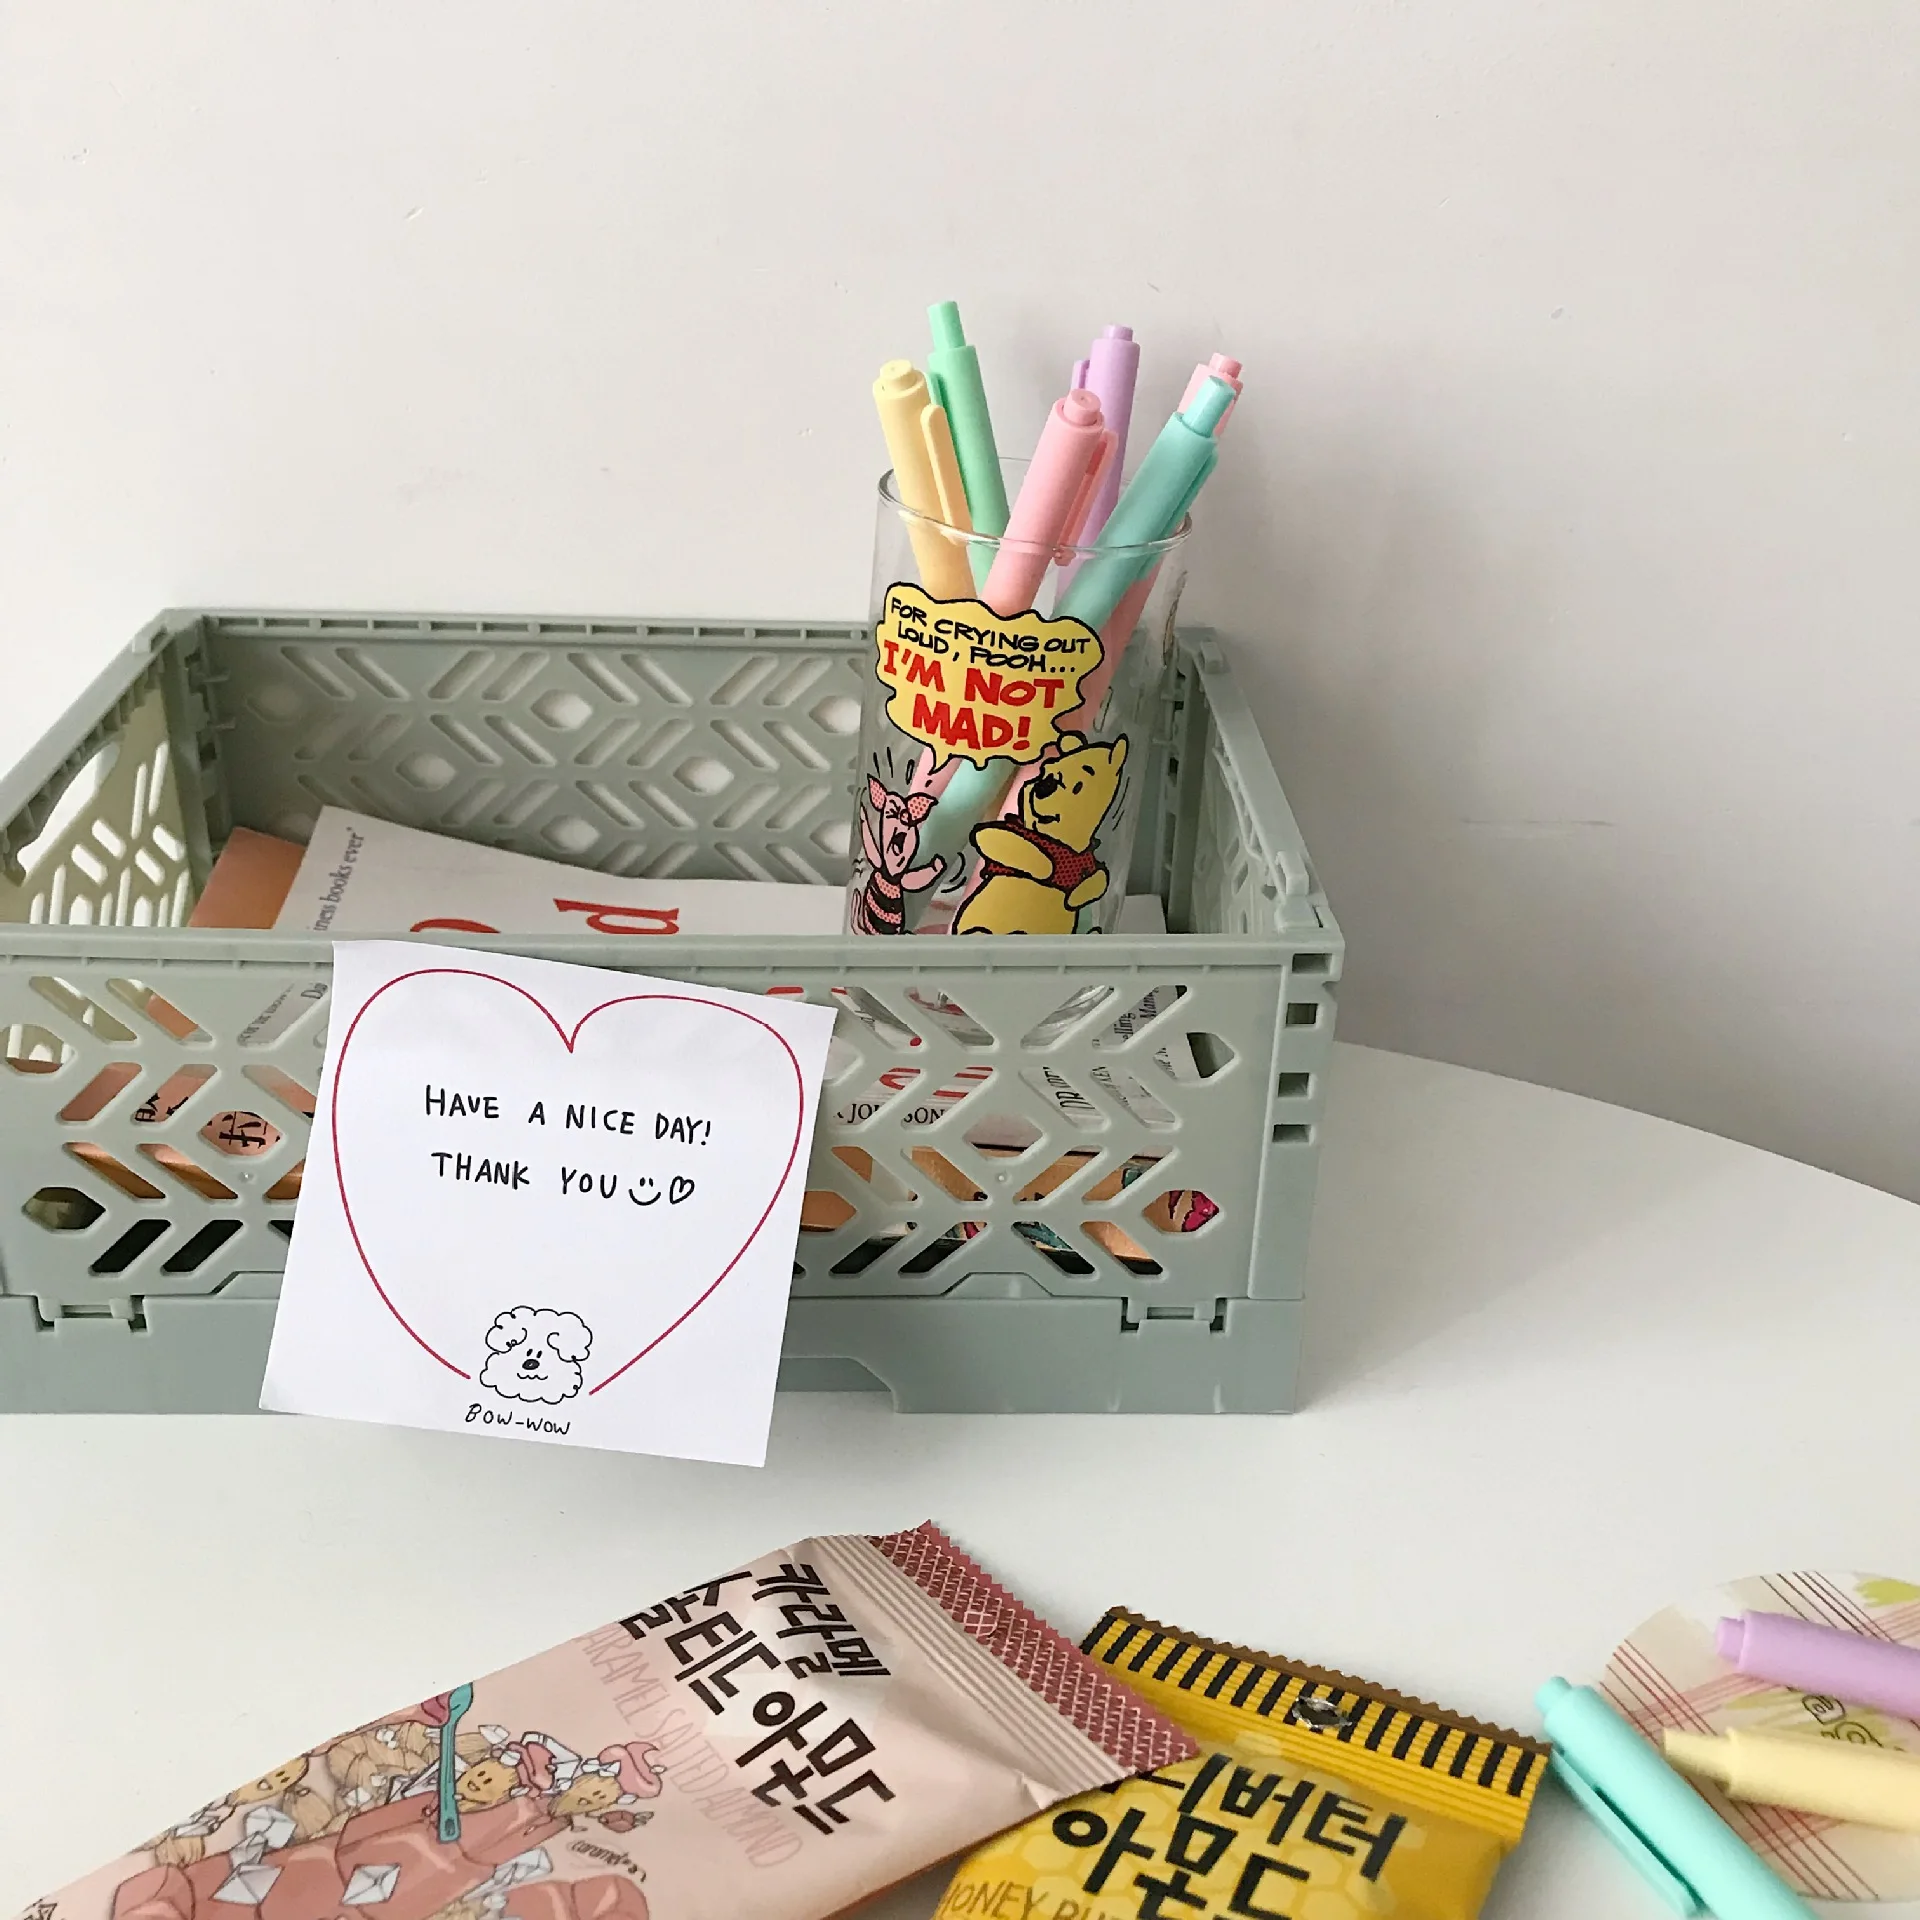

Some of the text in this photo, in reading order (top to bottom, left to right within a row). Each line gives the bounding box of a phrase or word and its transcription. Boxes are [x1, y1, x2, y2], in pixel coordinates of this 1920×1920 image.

[892, 597, 1091, 655] FOR CRYING OUT
[898, 621, 1076, 673] LOUD, POOH...
[883, 639, 1065, 709] I'M NOT
[912, 693, 1031, 751] MAD!
[319, 864, 353, 904] books
[425, 1084, 711, 1146] HAVE A NICE DAY!
[430, 1151, 618, 1199] THANK YOU
[752, 1564, 891, 1679] 카라멜
[735, 1691, 896, 1835] 아몬드
[1132, 1752, 1407, 1882] 니버터
